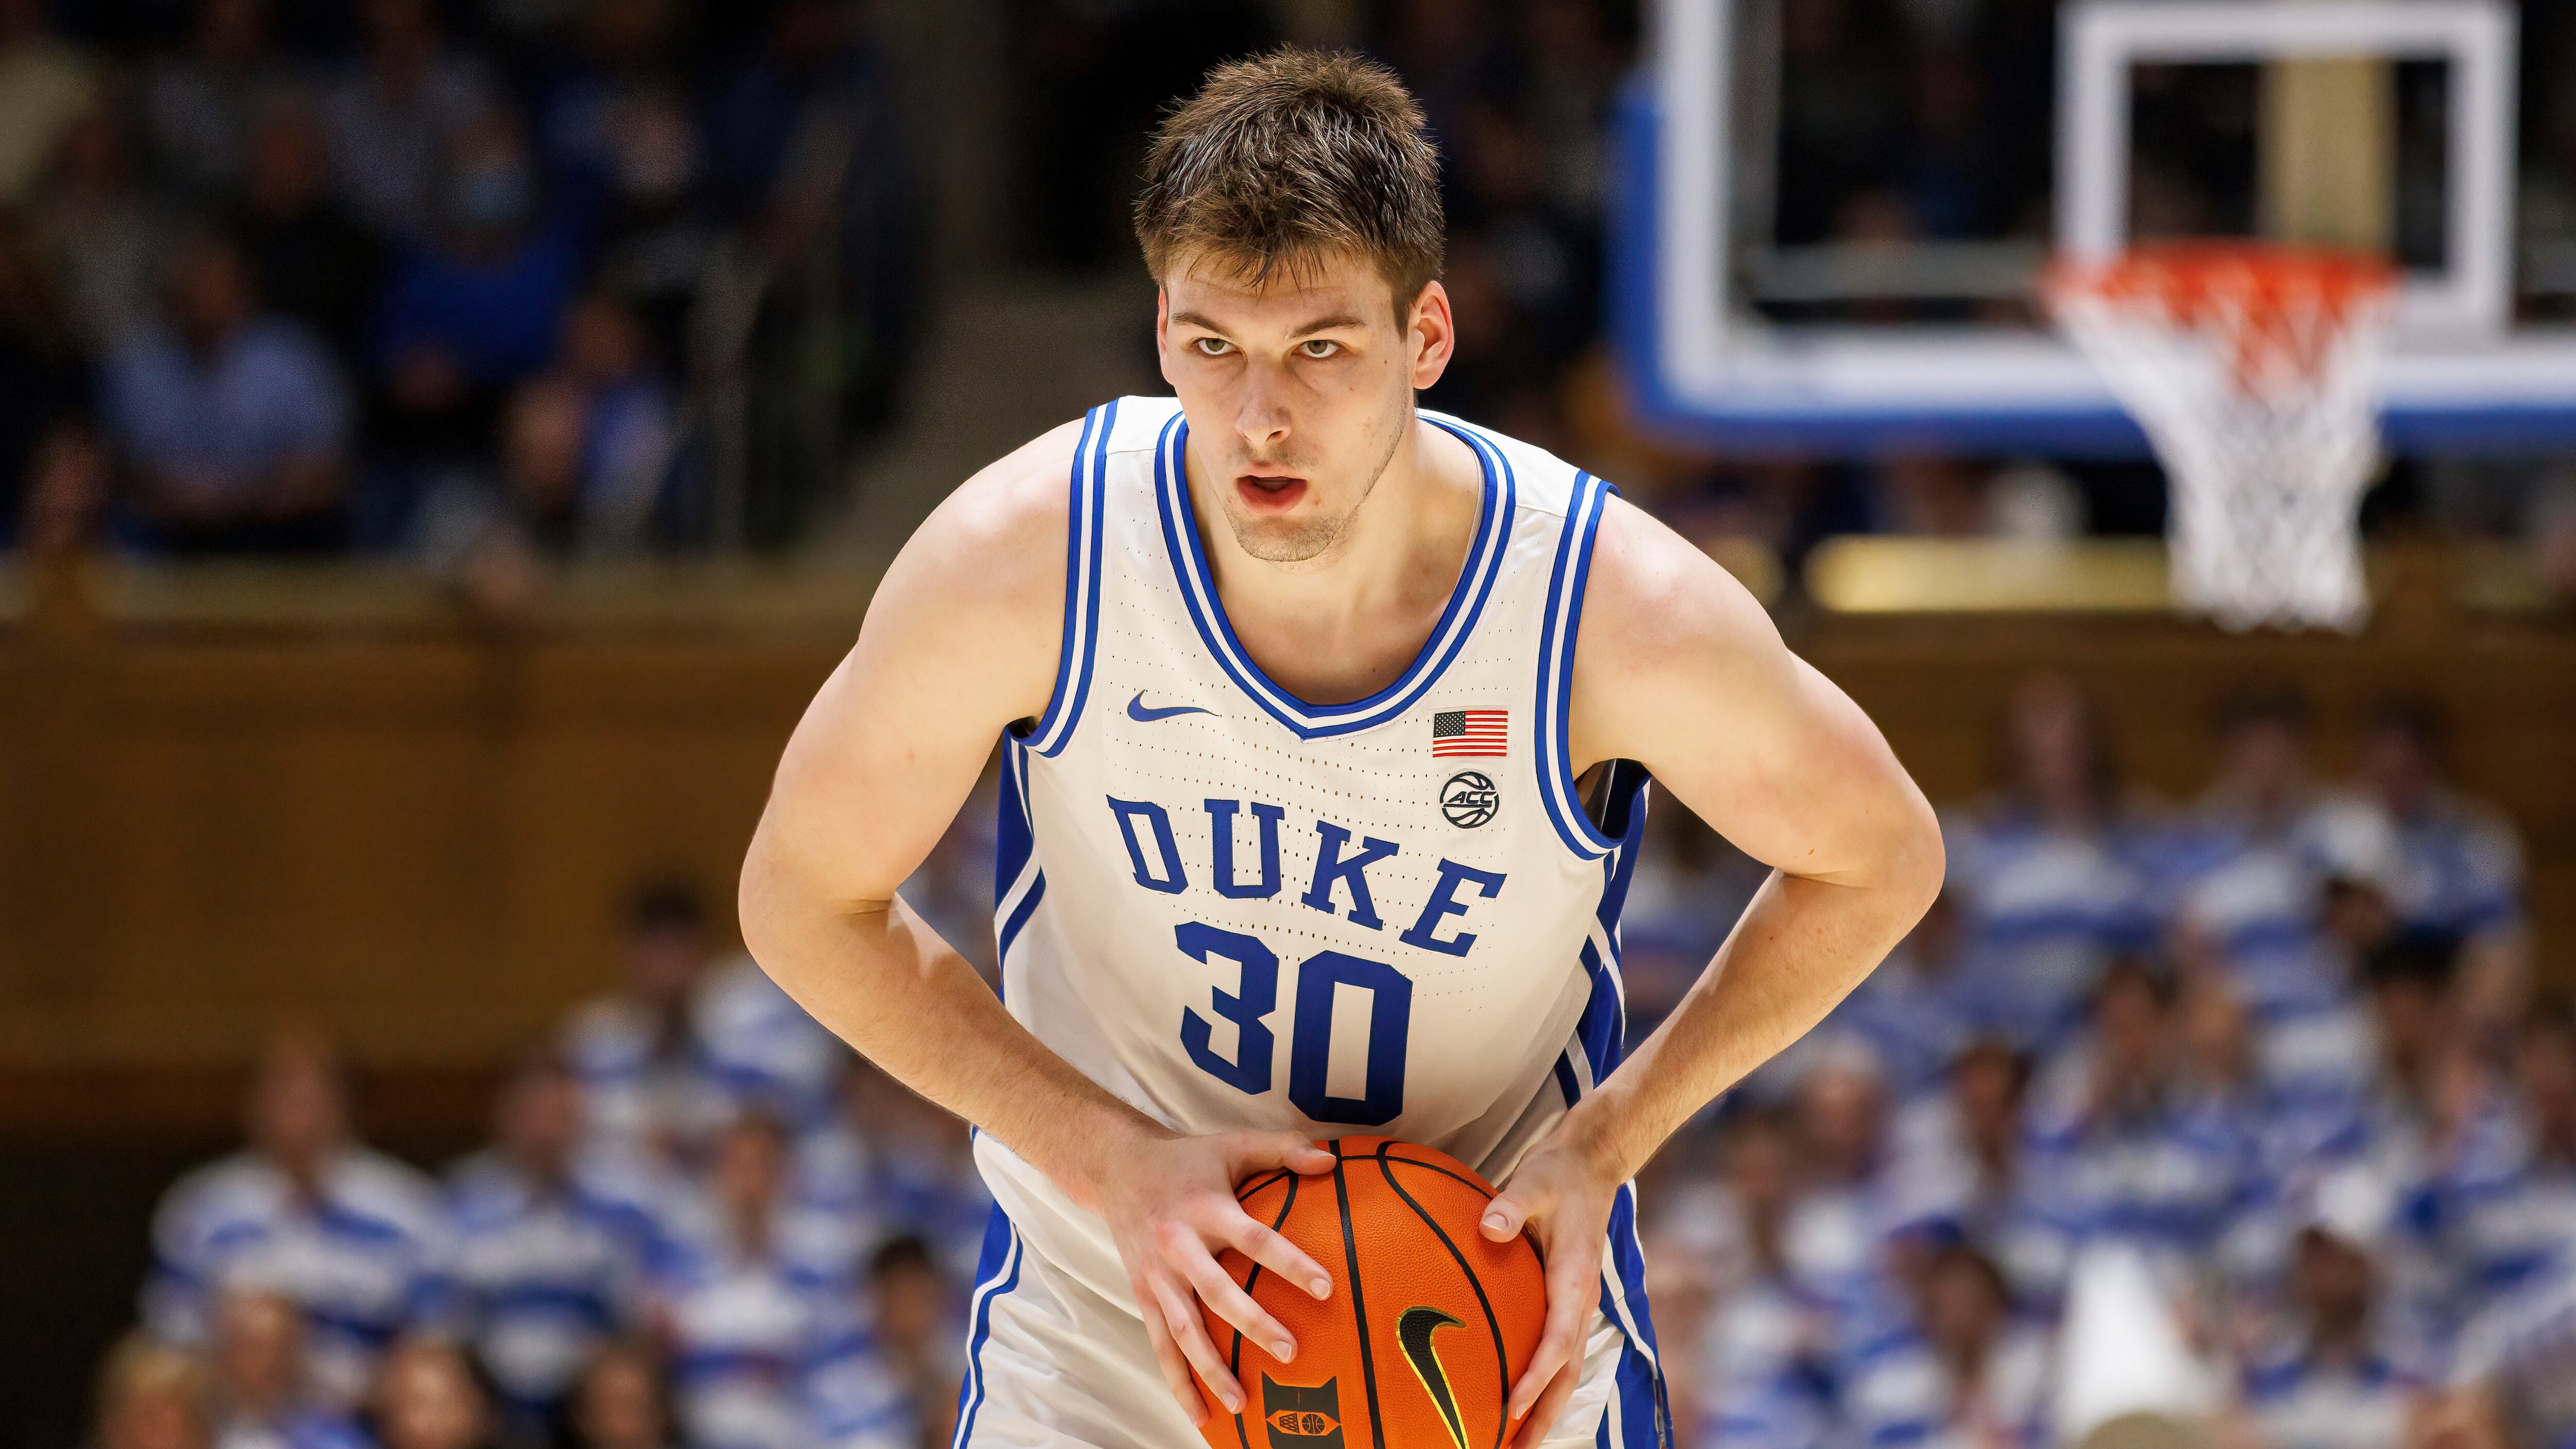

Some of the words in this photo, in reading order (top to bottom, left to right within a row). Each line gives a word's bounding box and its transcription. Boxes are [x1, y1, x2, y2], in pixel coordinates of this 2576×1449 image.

[1106, 795, 1507, 957] DUKE
[1447, 791, 1497, 804] ACC
[1175, 921, 1413, 1126] 30
